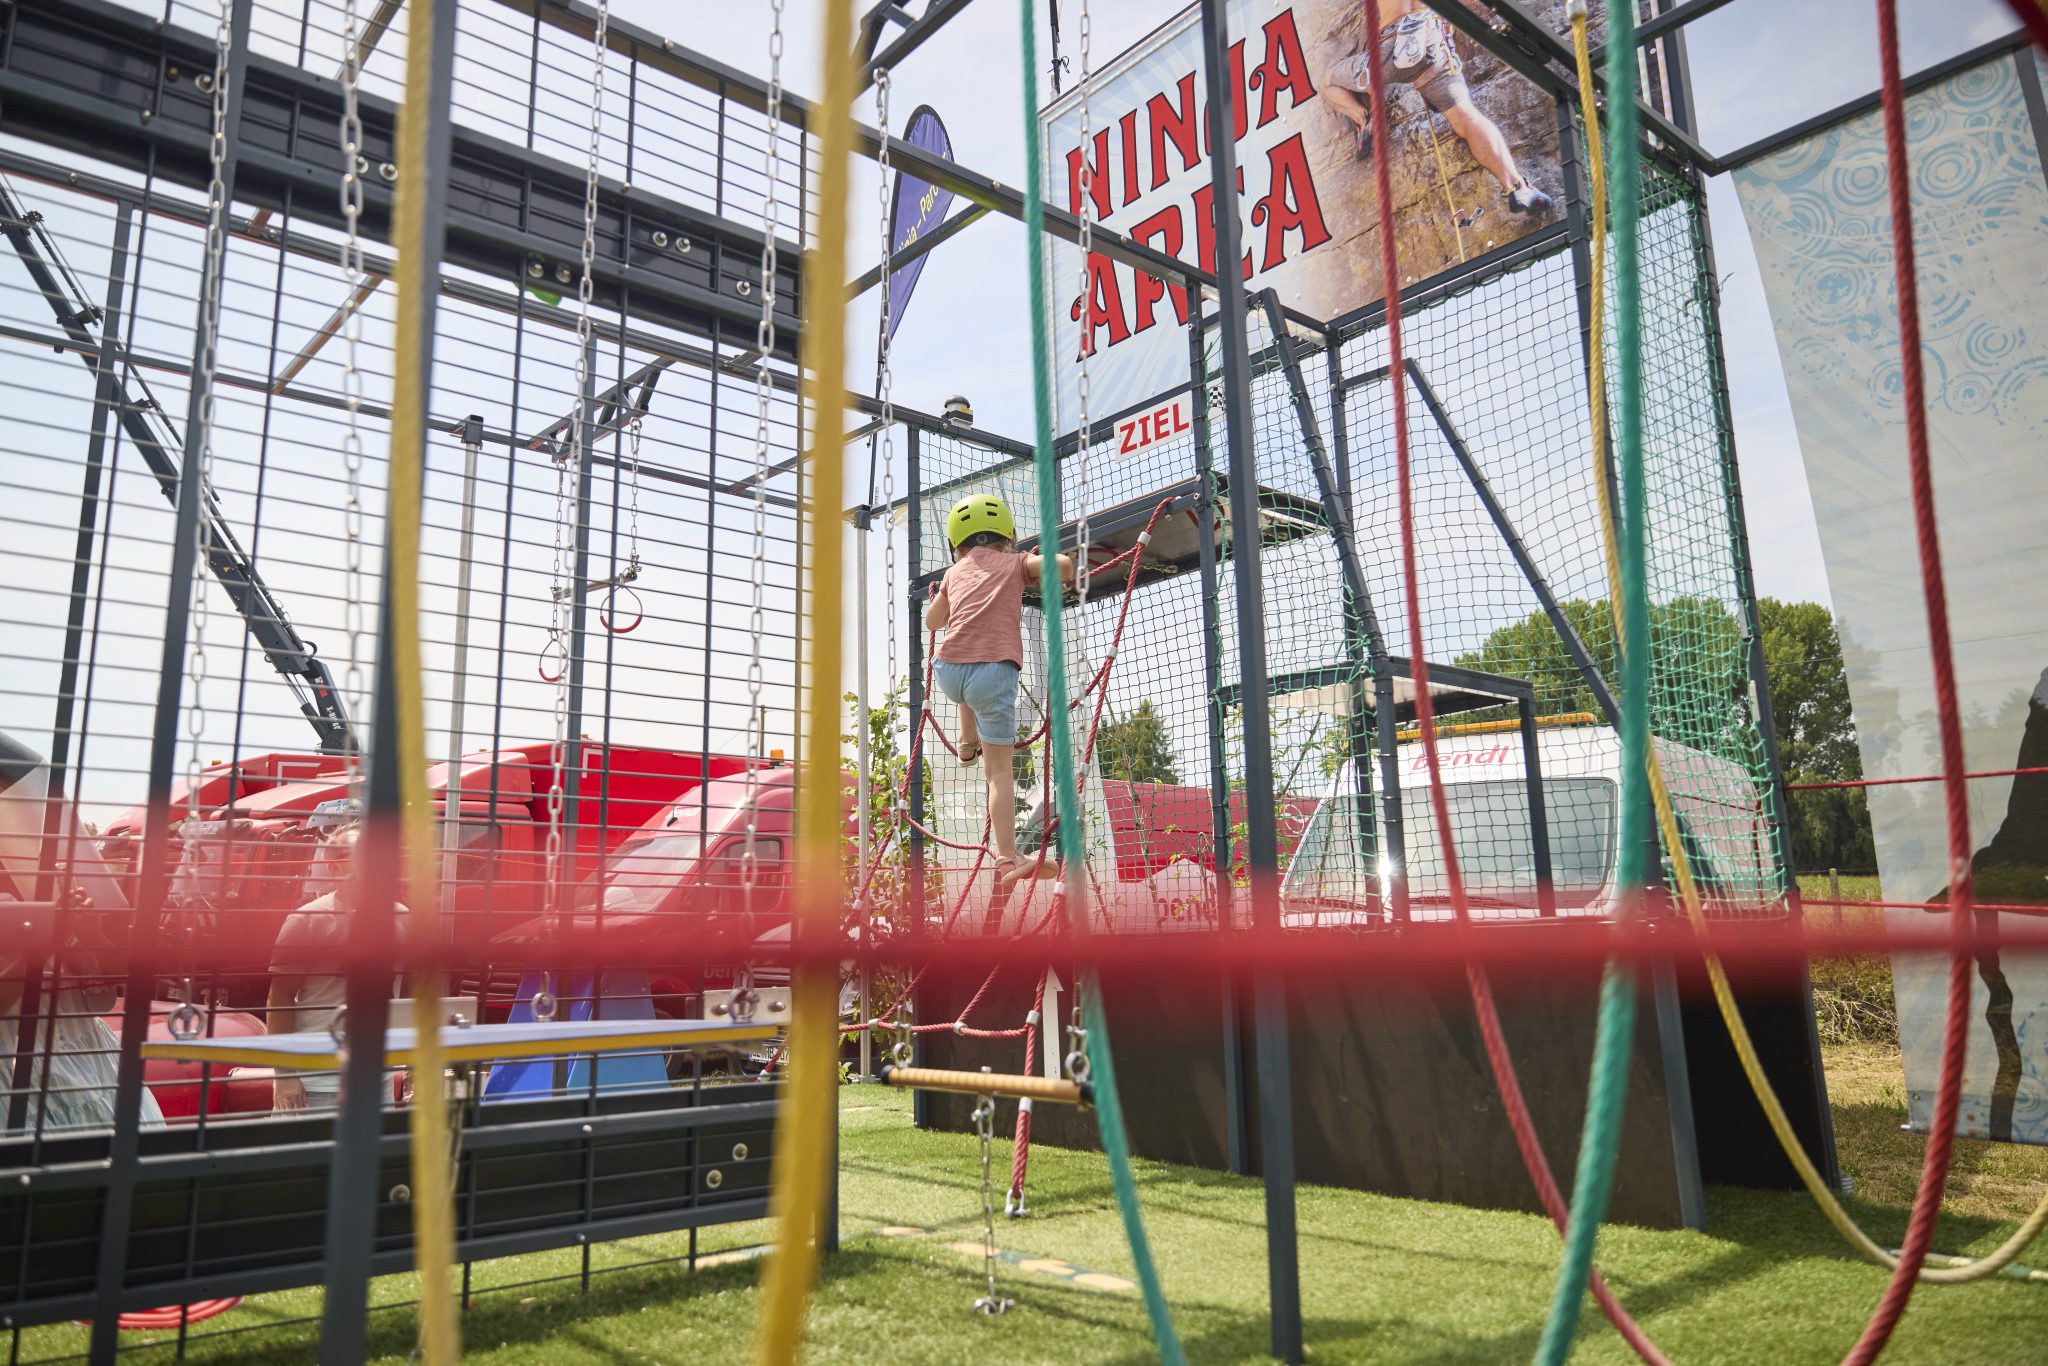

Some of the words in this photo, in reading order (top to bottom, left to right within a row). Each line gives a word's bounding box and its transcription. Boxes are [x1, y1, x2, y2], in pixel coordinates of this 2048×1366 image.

[1066, 7, 1318, 222] NINJA
[1071, 132, 1333, 363] AREA
[1119, 402, 1190, 455] ZIEL
